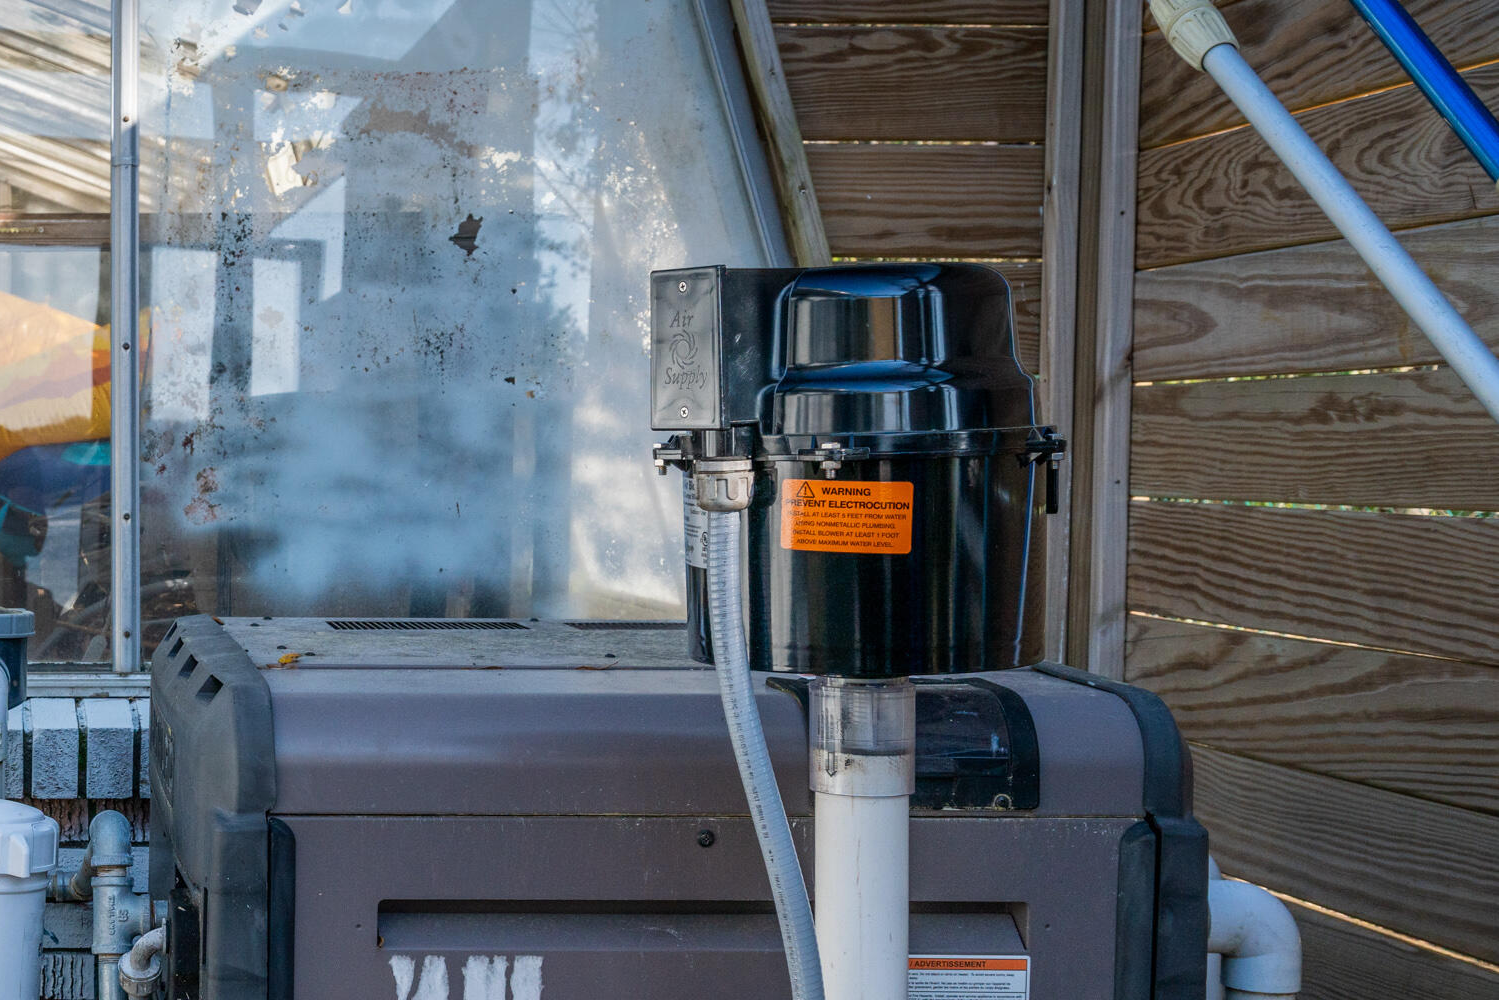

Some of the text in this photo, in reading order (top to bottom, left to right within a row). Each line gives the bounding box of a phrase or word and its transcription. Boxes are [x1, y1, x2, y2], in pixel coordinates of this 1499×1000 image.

[669, 309, 693, 328] Air
[664, 364, 708, 390] Supply
[821, 487, 871, 496] WARNING
[785, 498, 910, 510] PREVENT ELECTROCUTION
[914, 960, 987, 968] ADVERTISSEMENT
